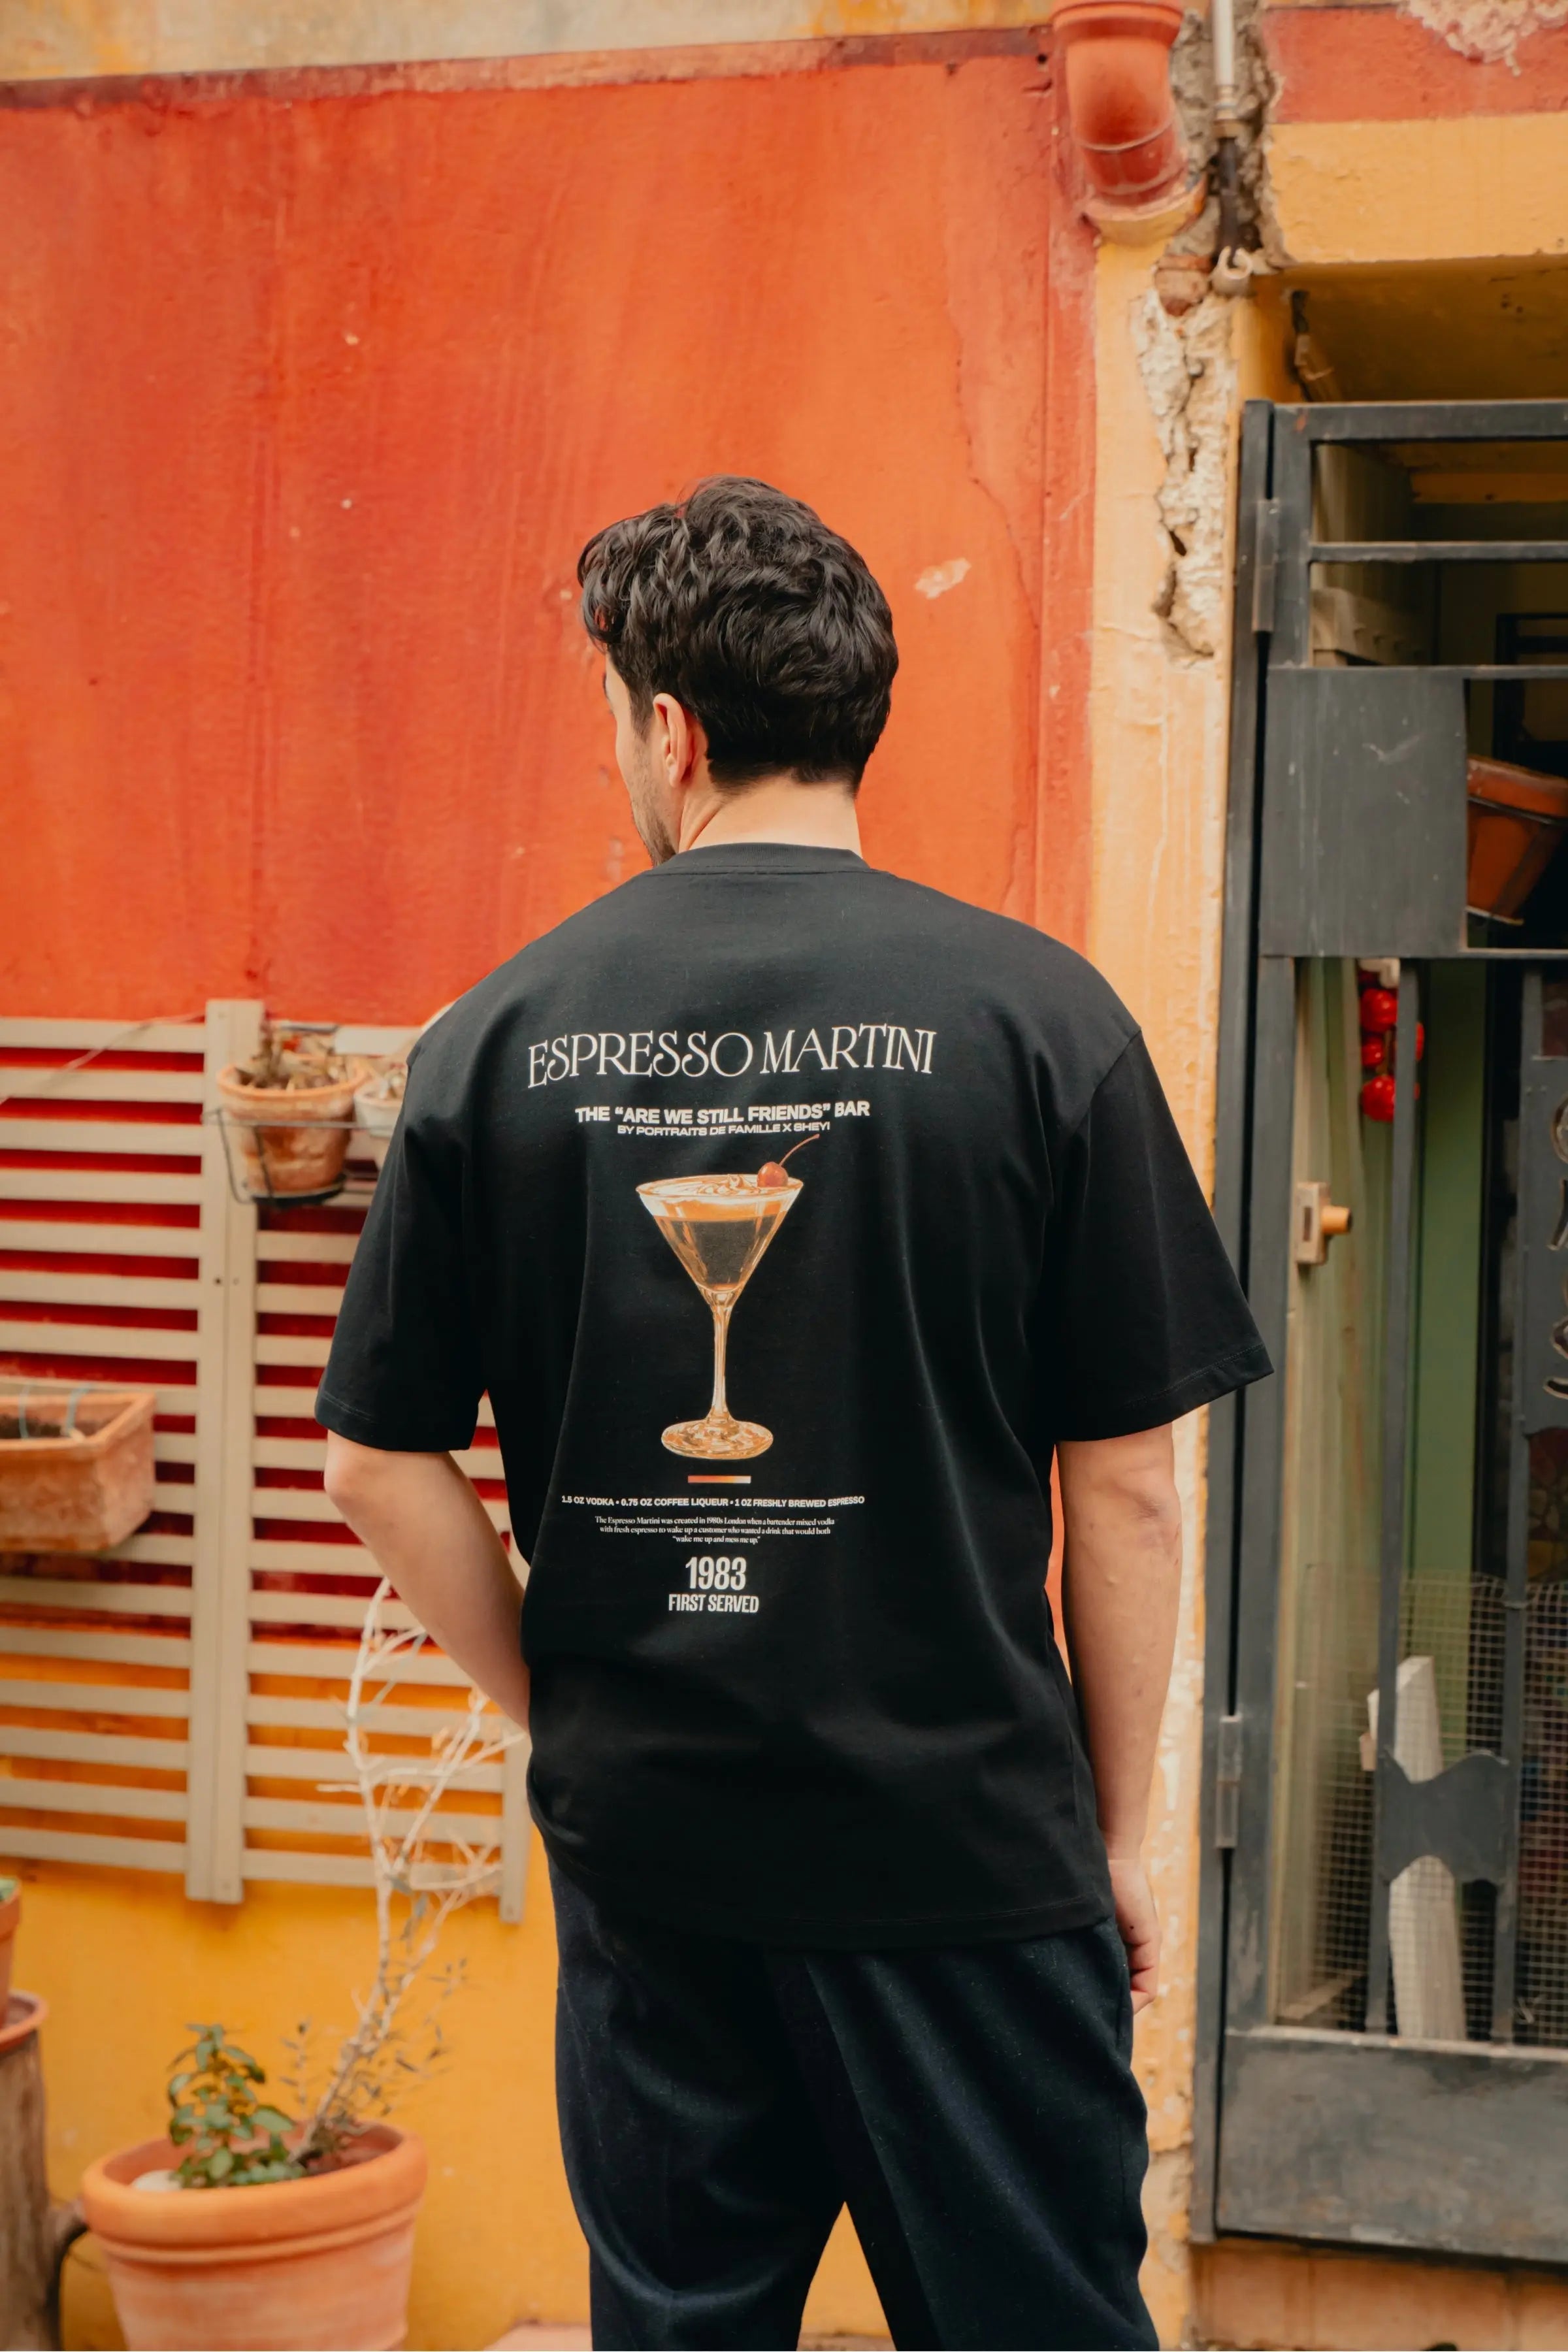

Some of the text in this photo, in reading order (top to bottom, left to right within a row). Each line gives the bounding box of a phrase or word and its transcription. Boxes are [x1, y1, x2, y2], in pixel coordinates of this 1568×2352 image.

[528, 1023, 937, 1088] ESPRESSO MARTINI
[575, 1101, 870, 1124] THE “ARE WE STILL FRIENDS” BAR
[617, 1122, 830, 1135] BY PORTRAITS DE FAMILLE X SHEYI
[586, 1497, 614, 1506] VODKA
[691, 1498, 728, 1507] LIQUEUR
[753, 1499, 787, 1507] FRESHLY
[828, 1496, 864, 1507] ESPRESSO
[685, 1557, 746, 1590] 1983
[669, 1594, 759, 1612] FIRST SERVED
